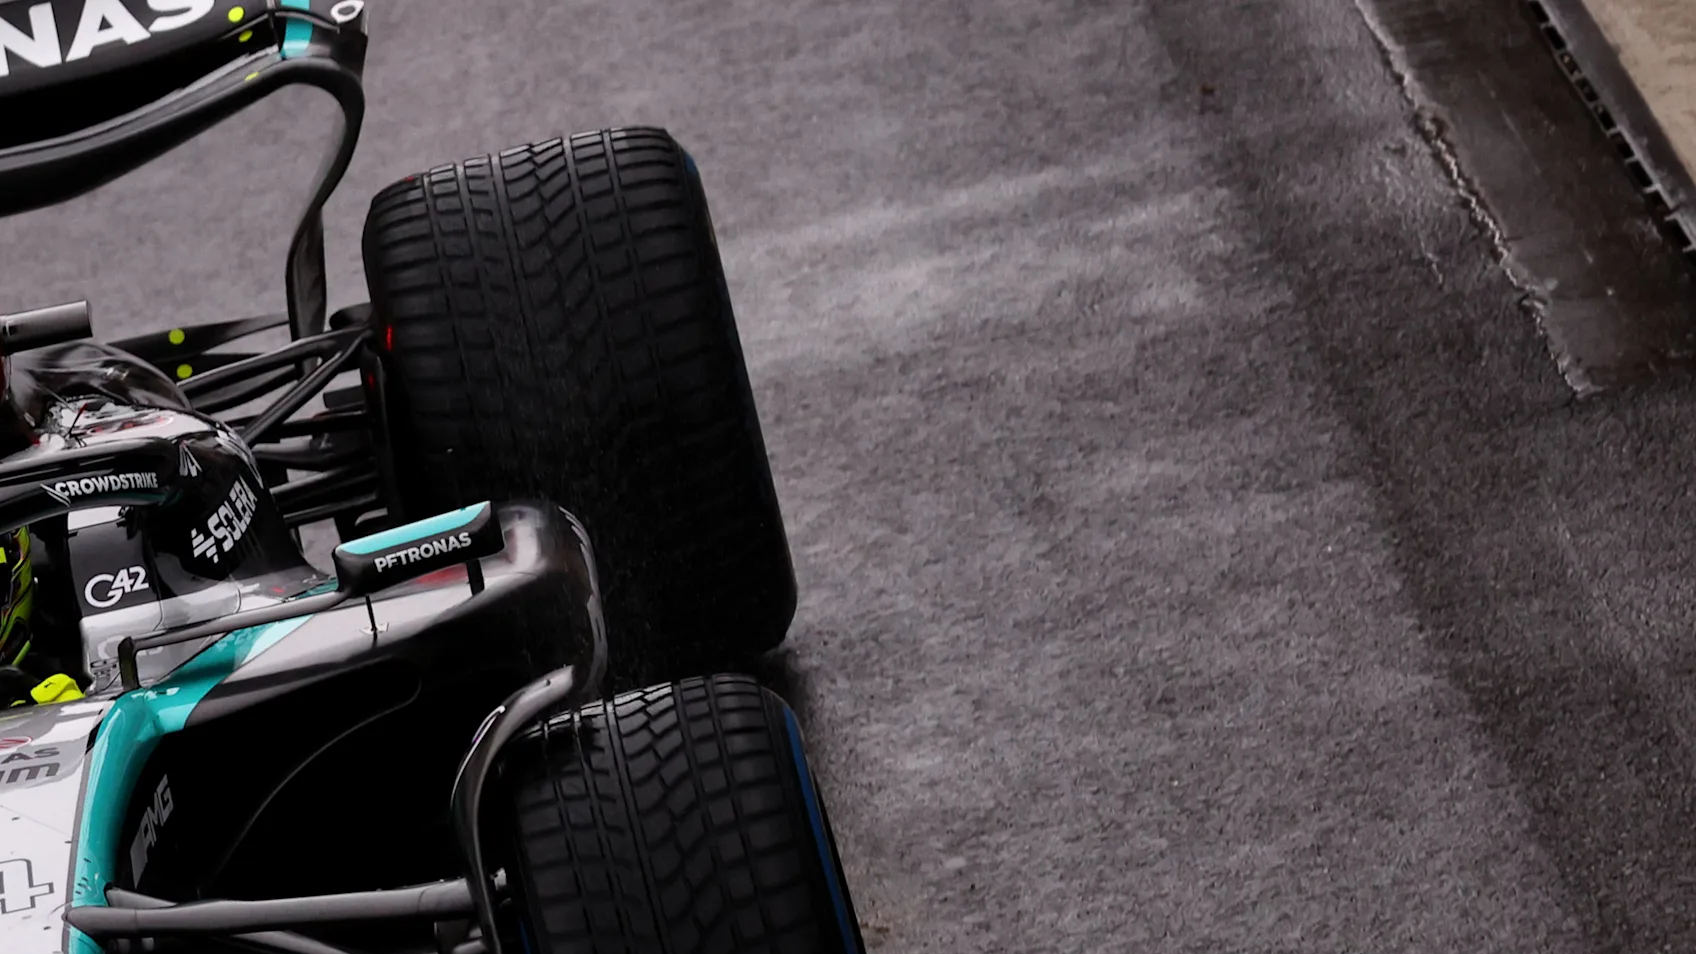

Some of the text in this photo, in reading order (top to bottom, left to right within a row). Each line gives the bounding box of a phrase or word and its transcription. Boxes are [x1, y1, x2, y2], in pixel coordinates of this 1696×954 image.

[54, 472, 158, 497] CROWDSTRIKE
[207, 474, 258, 552] SOLERA
[84, 565, 149, 608] G42
